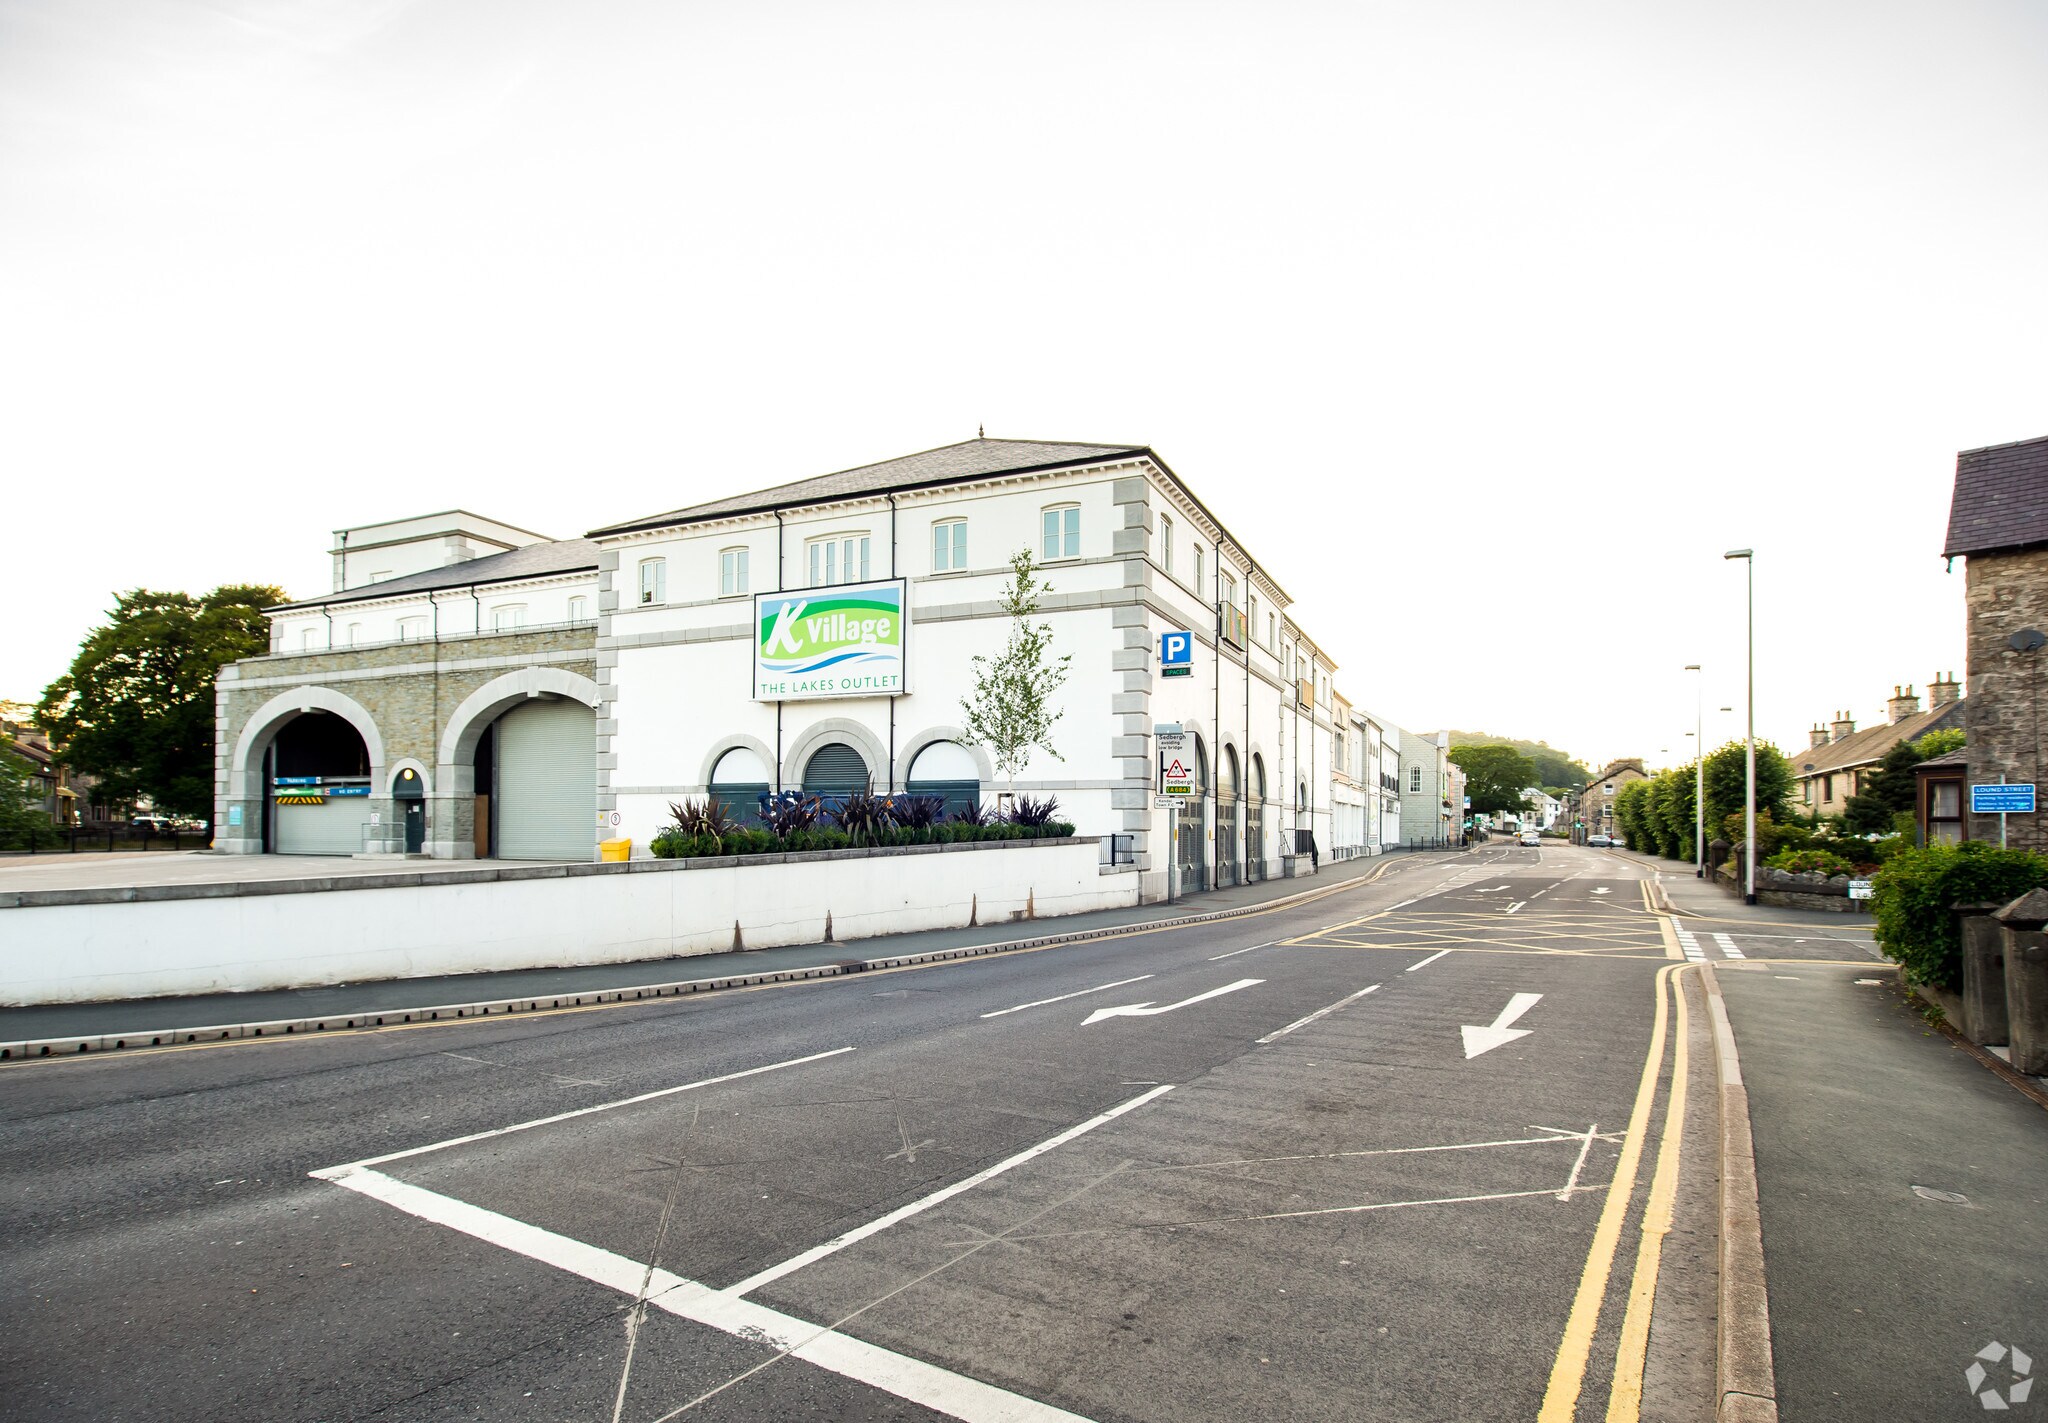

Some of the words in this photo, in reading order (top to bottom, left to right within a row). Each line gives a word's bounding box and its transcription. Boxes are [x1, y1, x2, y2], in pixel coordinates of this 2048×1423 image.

[765, 600, 808, 656] K
[806, 613, 891, 645] Village
[1168, 636, 1186, 661] P
[761, 682, 786, 695] THE
[792, 679, 834, 693] LAKES
[841, 675, 898, 690] OUTLET
